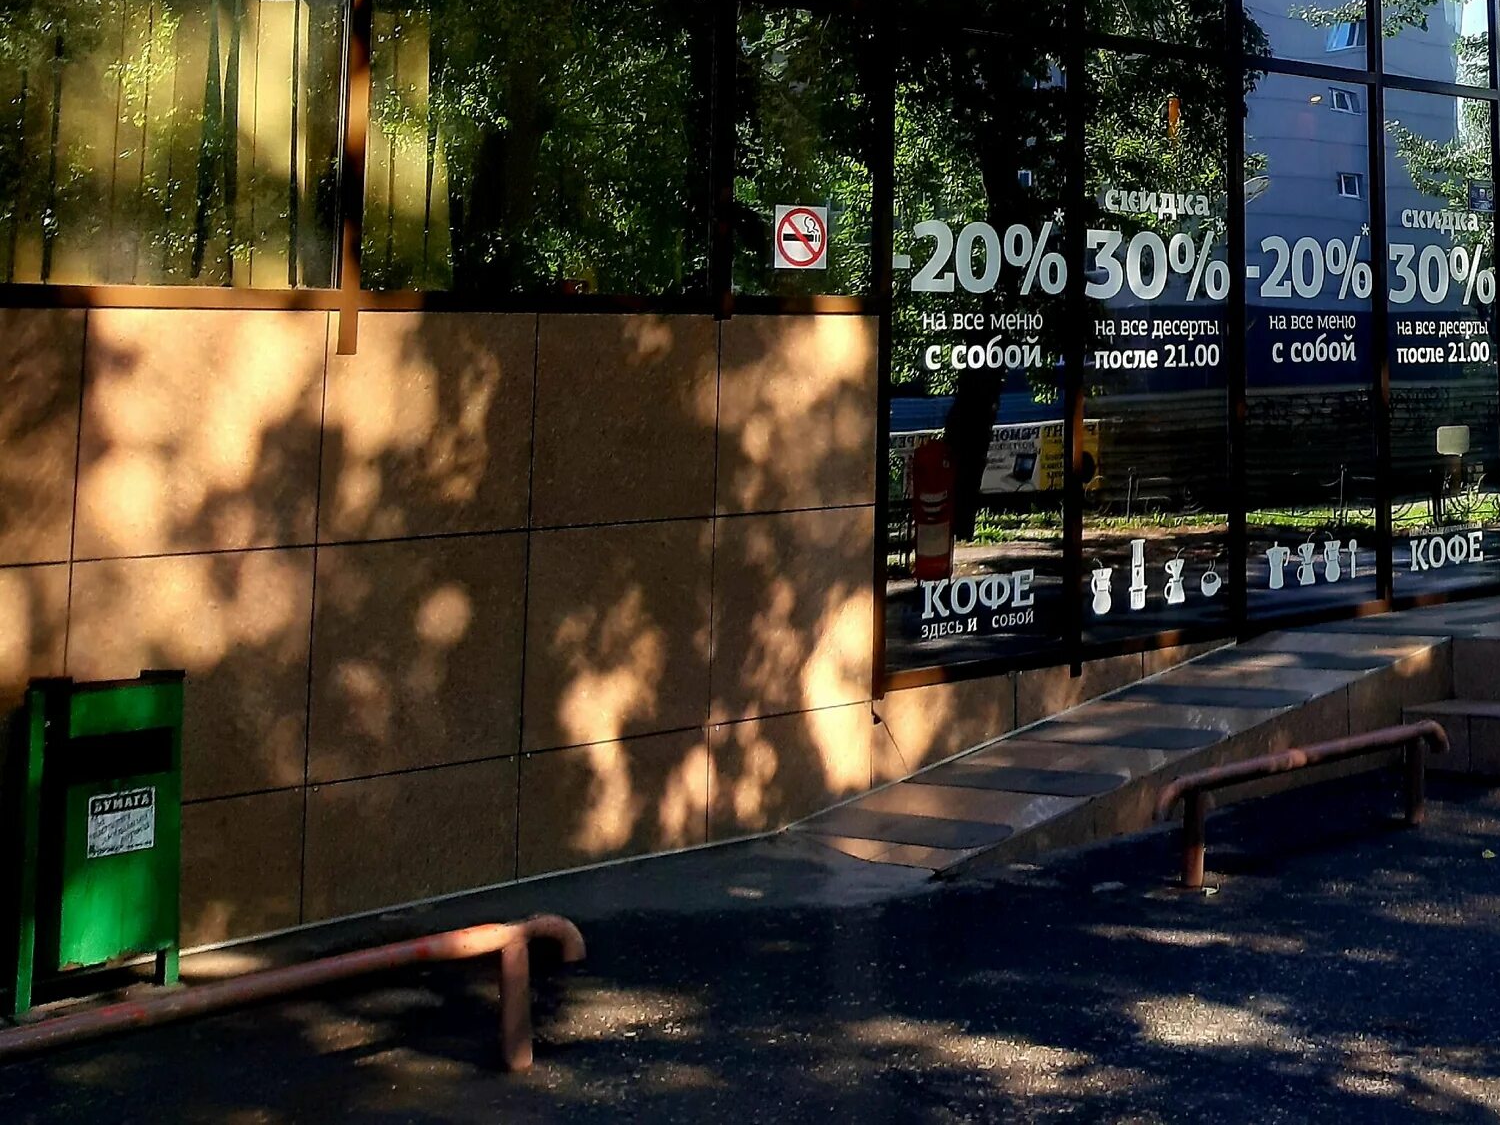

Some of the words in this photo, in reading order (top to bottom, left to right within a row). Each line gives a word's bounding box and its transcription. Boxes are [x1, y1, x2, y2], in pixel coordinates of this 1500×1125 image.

[1105, 189, 1210, 220] скидка
[1402, 209, 1479, 236] скидка
[922, 313, 947, 330] на
[952, 313, 984, 330] все
[990, 313, 1043, 330] меню
[1094, 320, 1116, 336] на
[1120, 320, 1148, 336] все
[1152, 320, 1219, 340] десерты
[1269, 315, 1287, 329] на
[1291, 315, 1313, 330] все
[1317, 315, 1356, 330] меню
[1397, 321, 1412, 335] на
[1415, 320, 1435, 335] все
[1439, 320, 1489, 339] десерты
[925, 344, 942, 370] с
[951, 334, 1043, 370] собой
[1094, 349, 1158, 369] после
[1164, 344, 1220, 368] 21.00
[1272, 342, 1284, 363] с
[1291, 333, 1357, 363] собой
[1397, 347, 1444, 363] после
[1448, 342, 1489, 363] 21.00
[1410, 531, 1484, 571] КОФЕ
[921, 569, 1034, 619] КОФЕ
[921, 621, 963, 640] ЗДЕСЬ
[967, 618, 977, 632] И
[992, 608, 1034, 628] СОБОЙ
